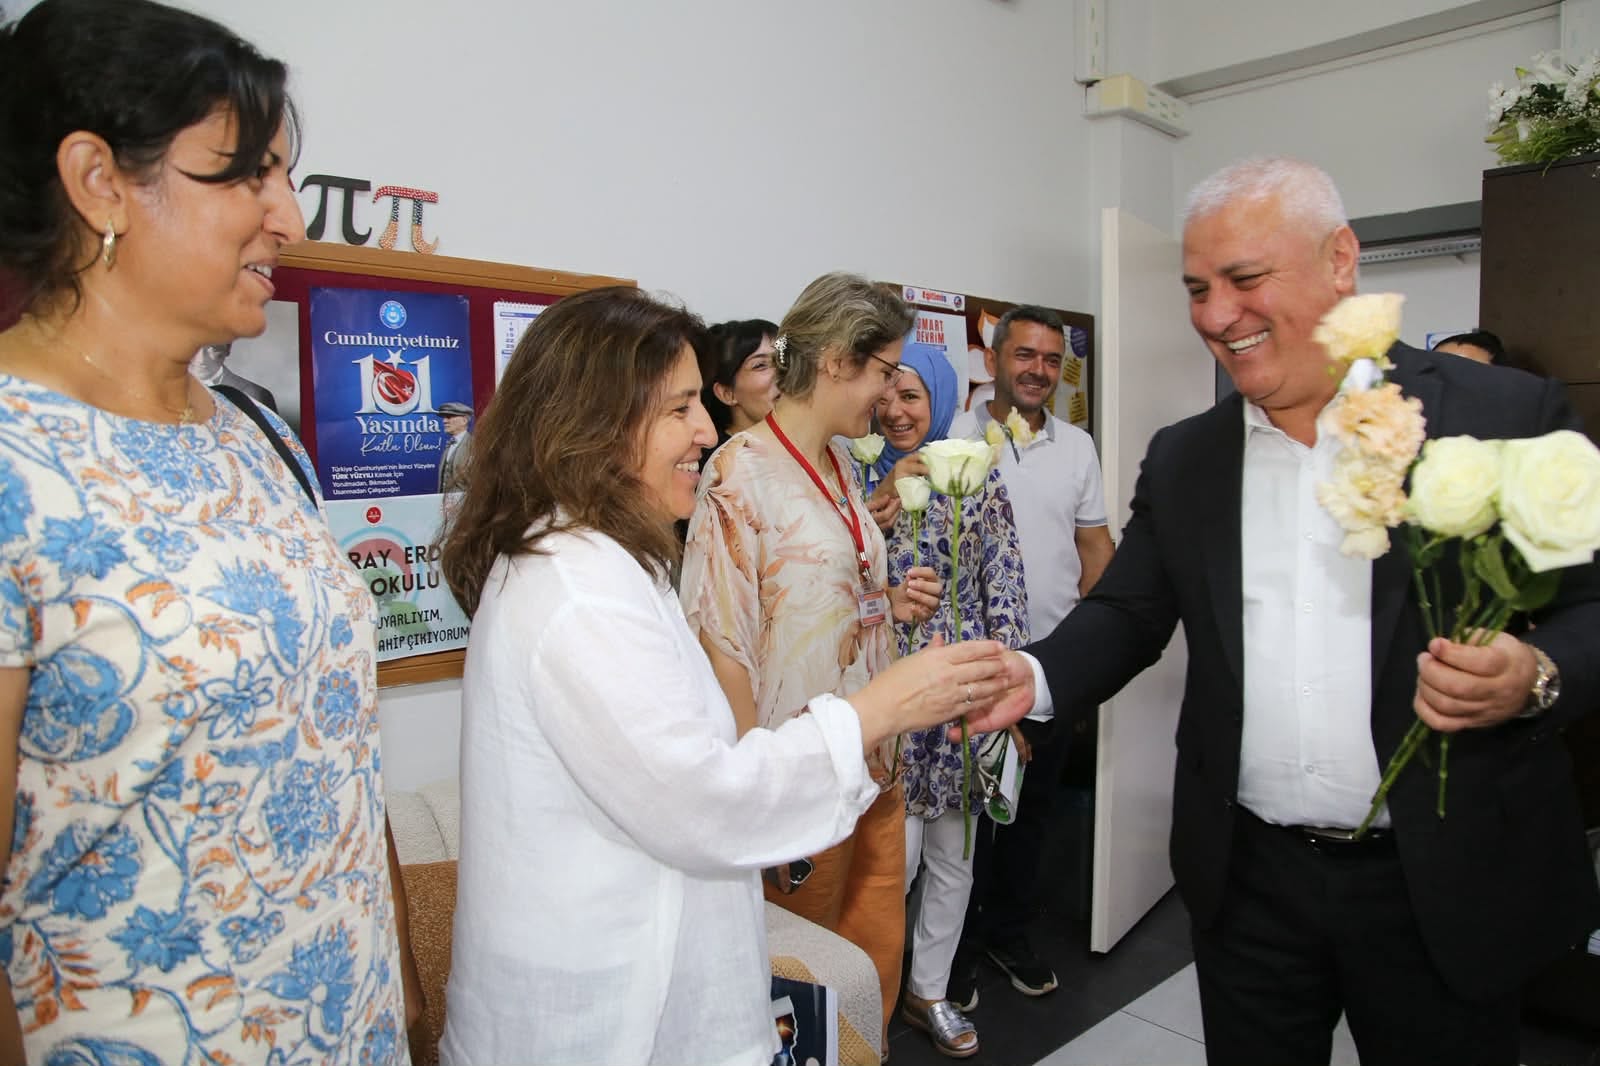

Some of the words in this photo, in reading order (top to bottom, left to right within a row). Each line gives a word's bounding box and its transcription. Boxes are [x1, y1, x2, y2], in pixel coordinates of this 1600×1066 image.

[324, 331, 459, 350] Cumhuriyetimiz
[355, 415, 441, 435] Yaşında
[360, 434, 401, 457] Kutlu
[404, 433, 442, 454] Olsun!
[332, 472, 348, 480] TÜRK
[370, 571, 440, 596] OKULU
